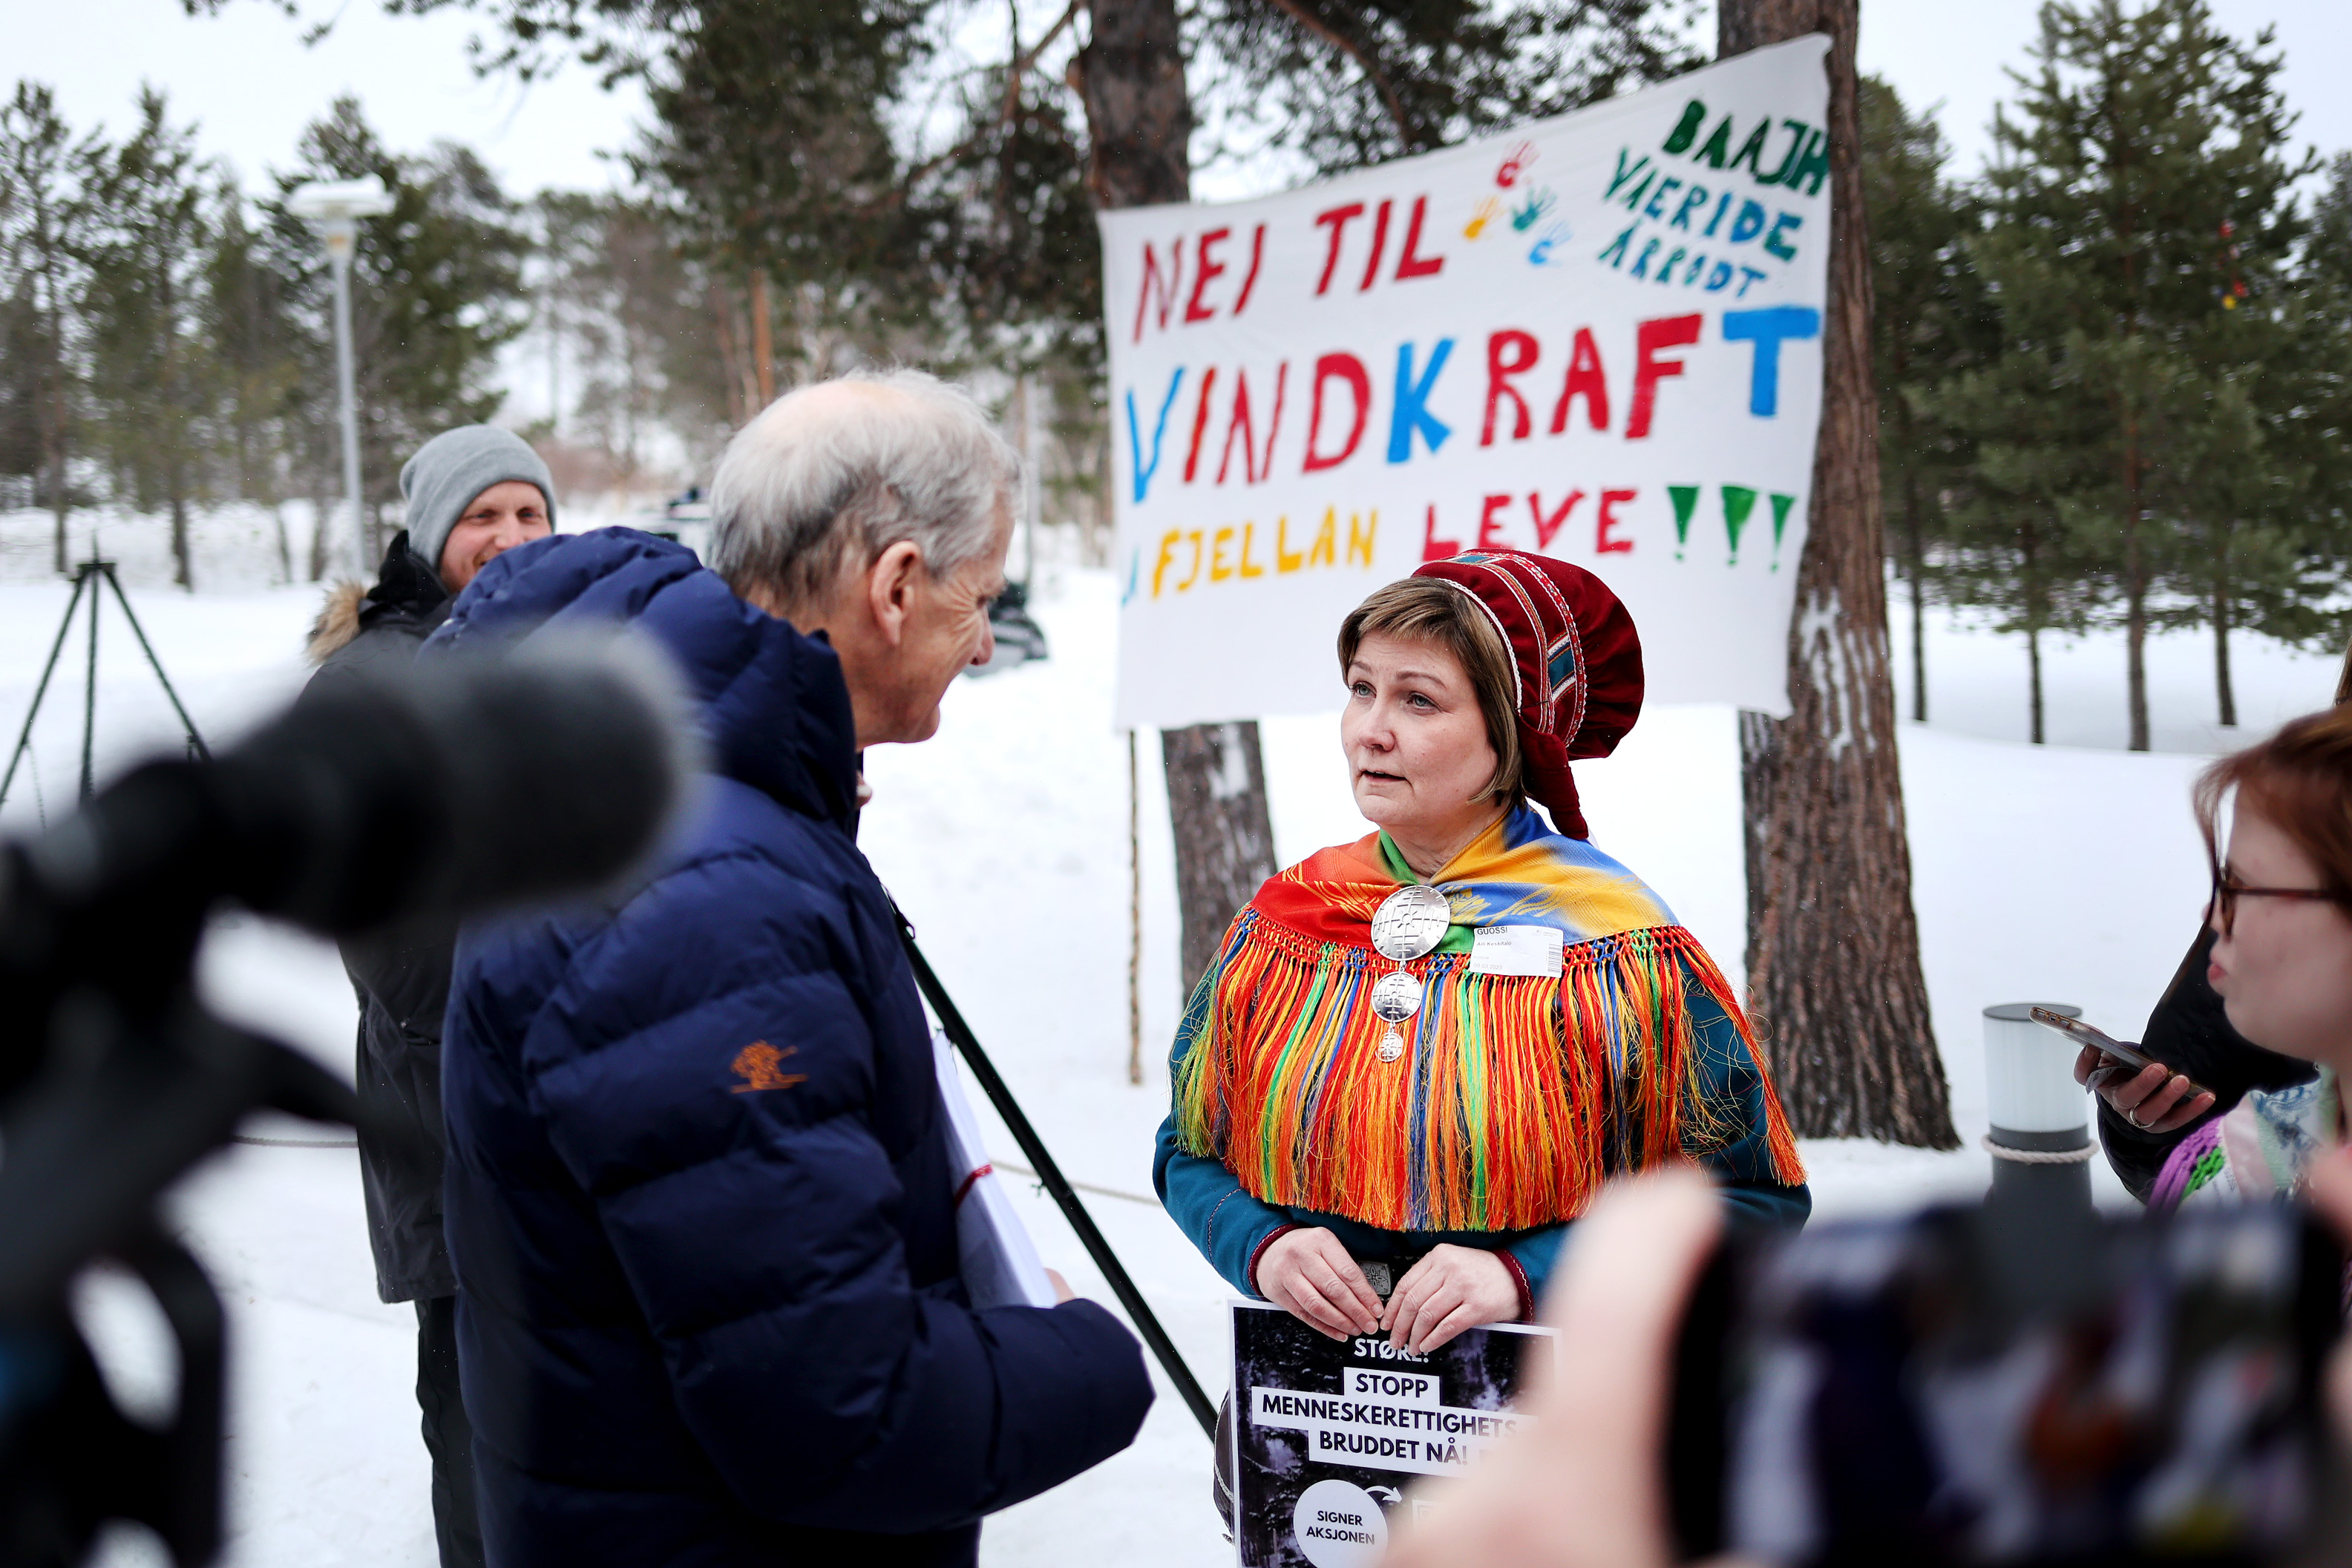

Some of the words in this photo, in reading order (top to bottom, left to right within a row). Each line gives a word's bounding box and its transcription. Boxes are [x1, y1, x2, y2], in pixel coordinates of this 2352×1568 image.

[1132, 223, 1266, 344] NEI
[1314, 194, 1447, 295] TIL
[1127, 304, 1820, 503] VINDKRAFT
[1152, 505, 1378, 599] FJELLAN
[1422, 488, 1637, 562] LEVE
[1477, 927, 1508, 935] GUOSSI
[1355, 1373, 1429, 1398] STOPP
[1320, 1430, 1420, 1460] BRUDDET
[1426, 1437, 1469, 1466] NÅ!
[1317, 1509, 1363, 1526] SIGNER
[1306, 1526, 1375, 1546] AKSJONEN
